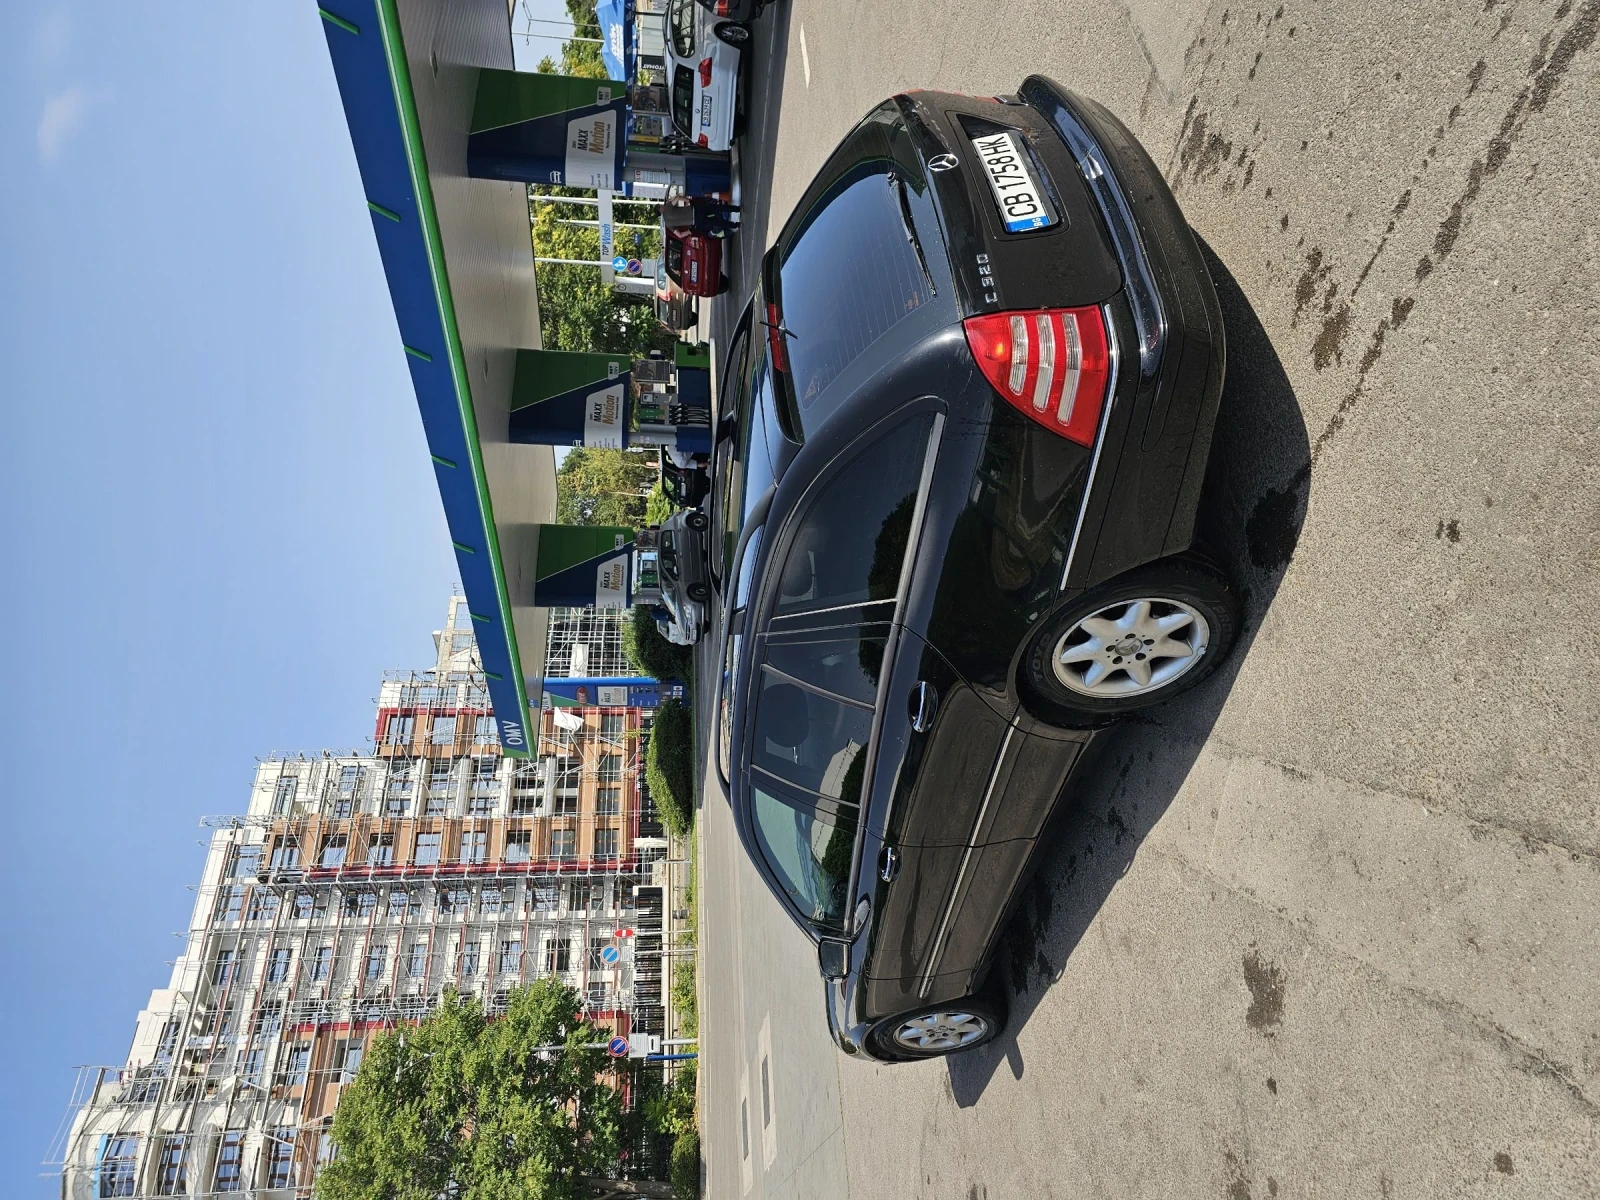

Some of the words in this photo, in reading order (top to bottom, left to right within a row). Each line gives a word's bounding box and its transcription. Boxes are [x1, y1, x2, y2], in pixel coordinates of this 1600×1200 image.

[577, 129, 588, 151] MAXX
[589, 121, 605, 154] Motion
[977, 136, 1011, 156] HK
[986, 155, 1027, 190] 1758
[1004, 192, 1038, 217] CB
[1031, 217, 1043, 227] BG
[976, 252, 995, 288] 320
[984, 291, 998, 304] C
[593, 402, 603, 422] MAXX
[602, 394, 615, 425] Motion
[603, 571, 611, 589] MAXX
[611, 563, 621, 591] Motion
[1032, 633, 1052, 682] TOYO
[502, 721, 523, 745] OMV
